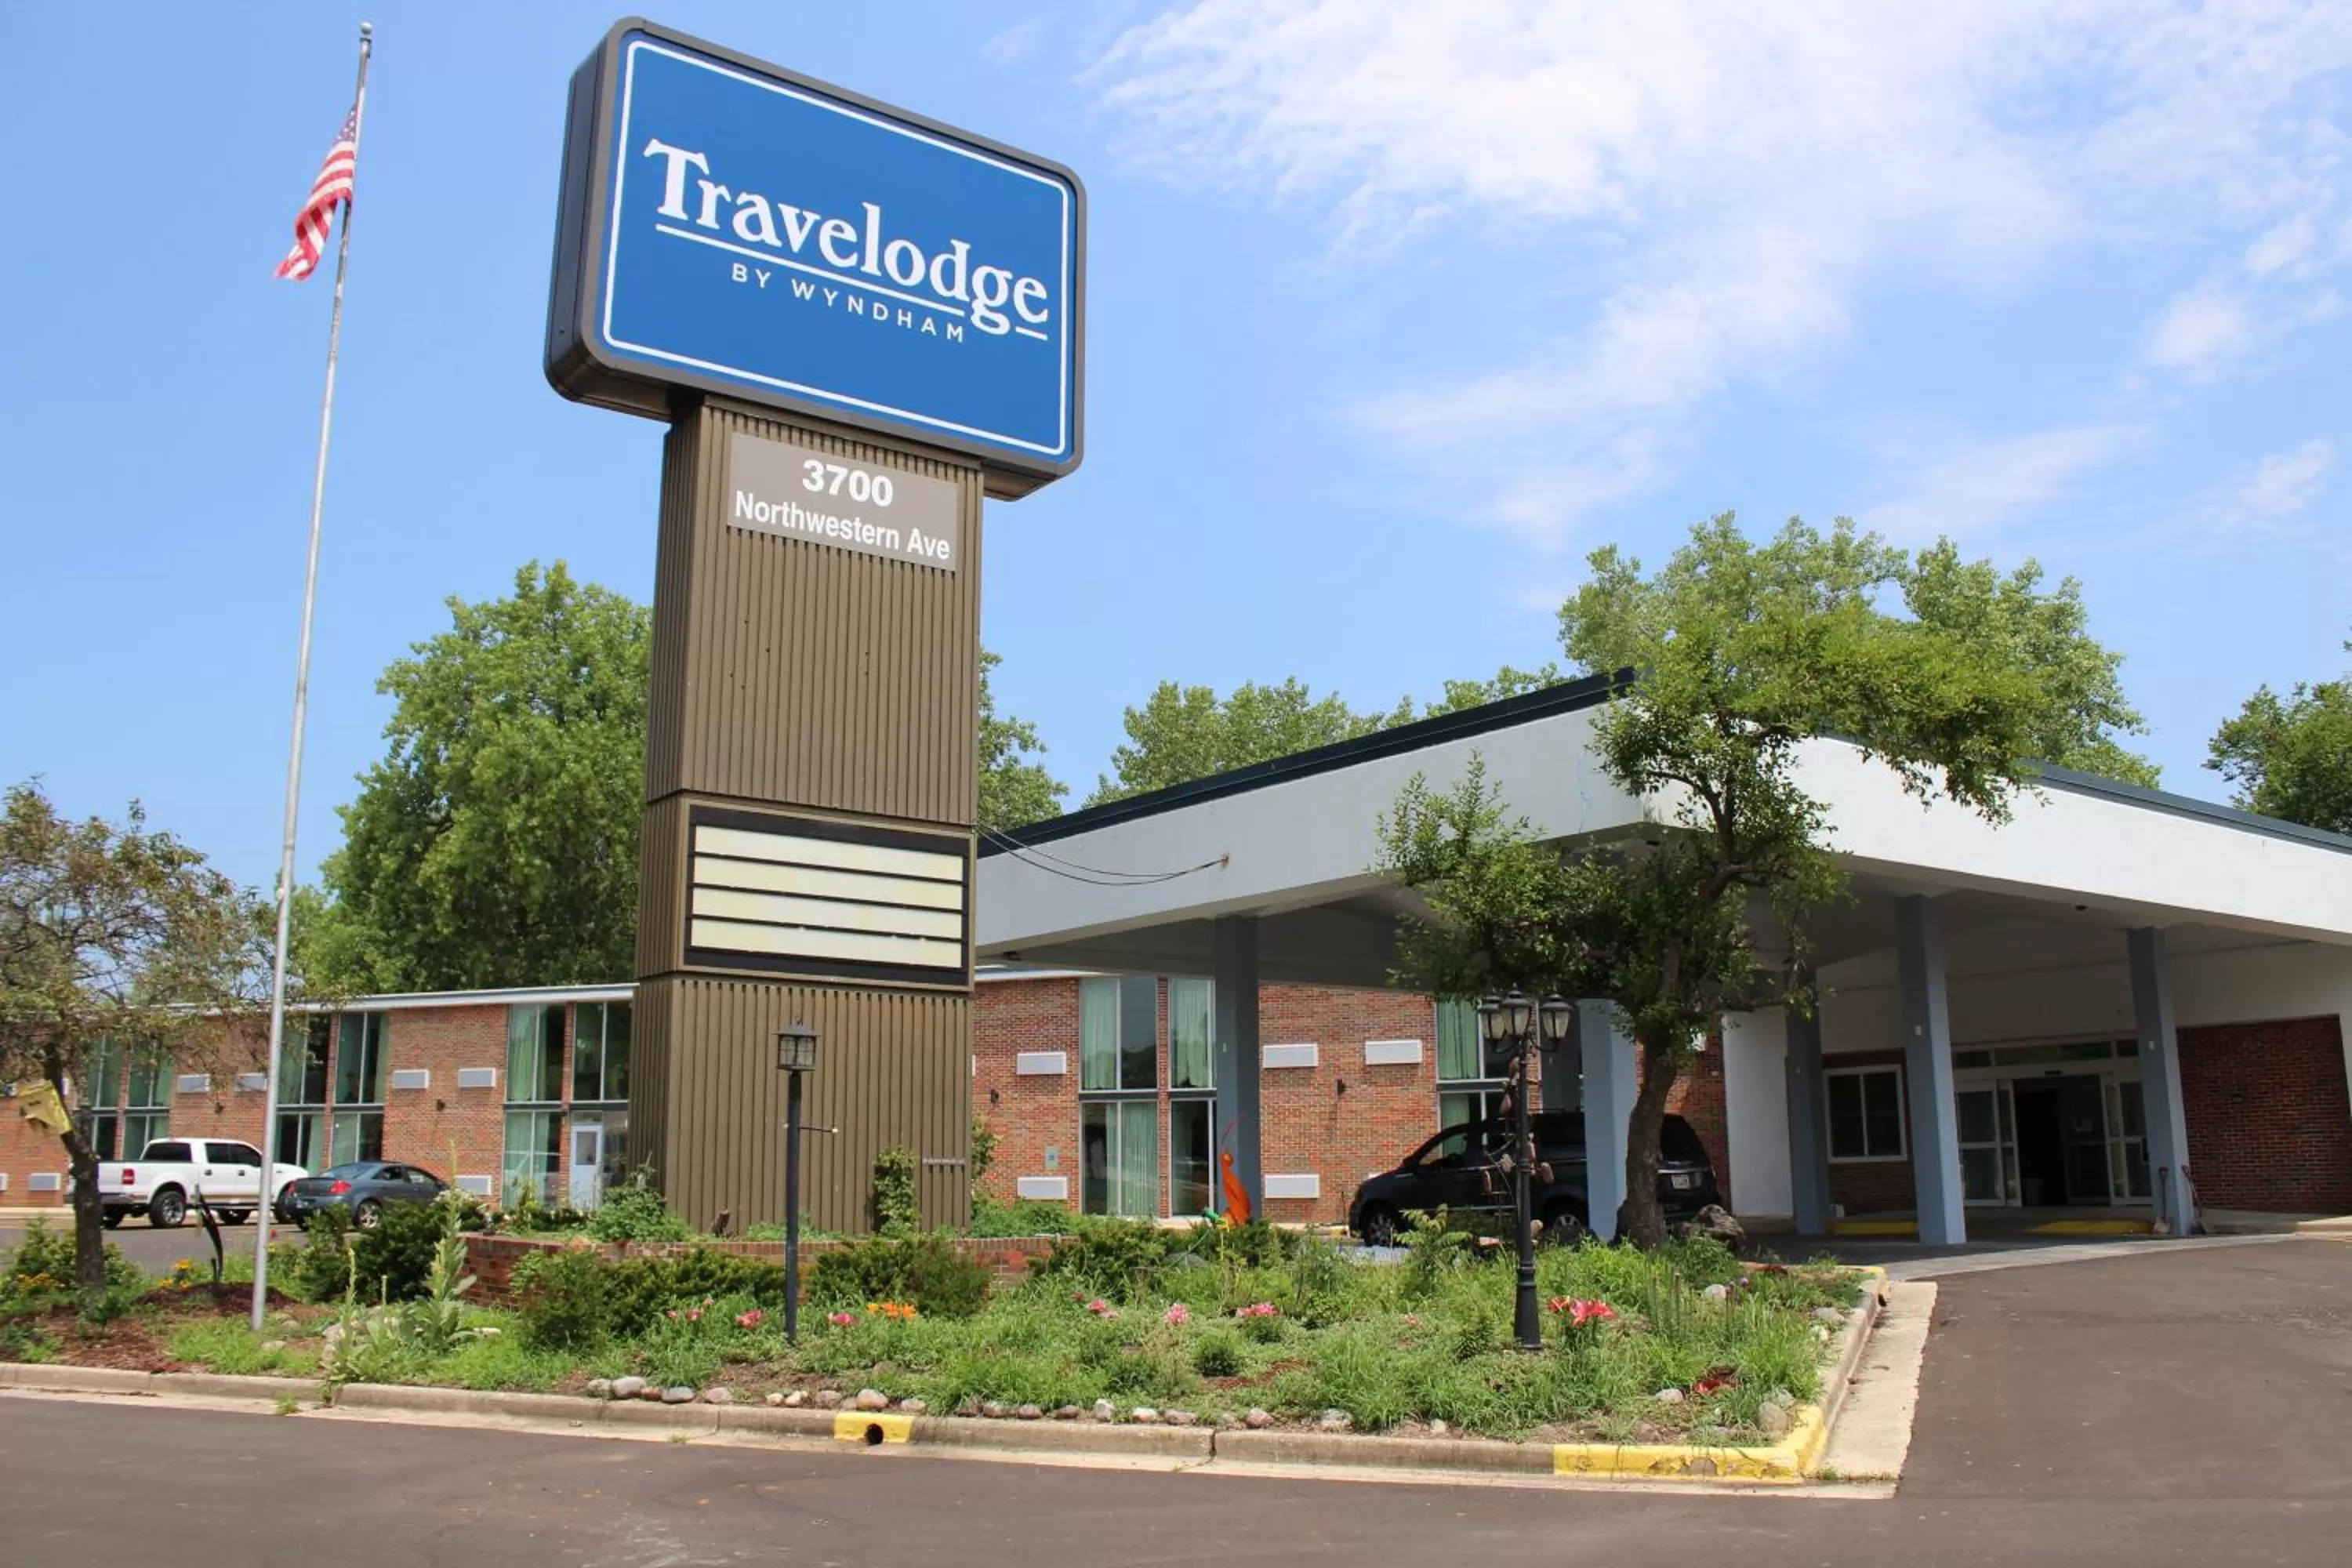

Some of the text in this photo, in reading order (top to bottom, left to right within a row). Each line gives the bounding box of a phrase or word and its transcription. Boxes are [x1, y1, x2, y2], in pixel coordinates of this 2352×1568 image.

[643, 138, 1048, 335] Travelodge
[732, 263, 964, 343] BY WYNDHAM
[802, 459, 894, 508] 3700
[735, 490, 951, 561] Northwestern Ave
